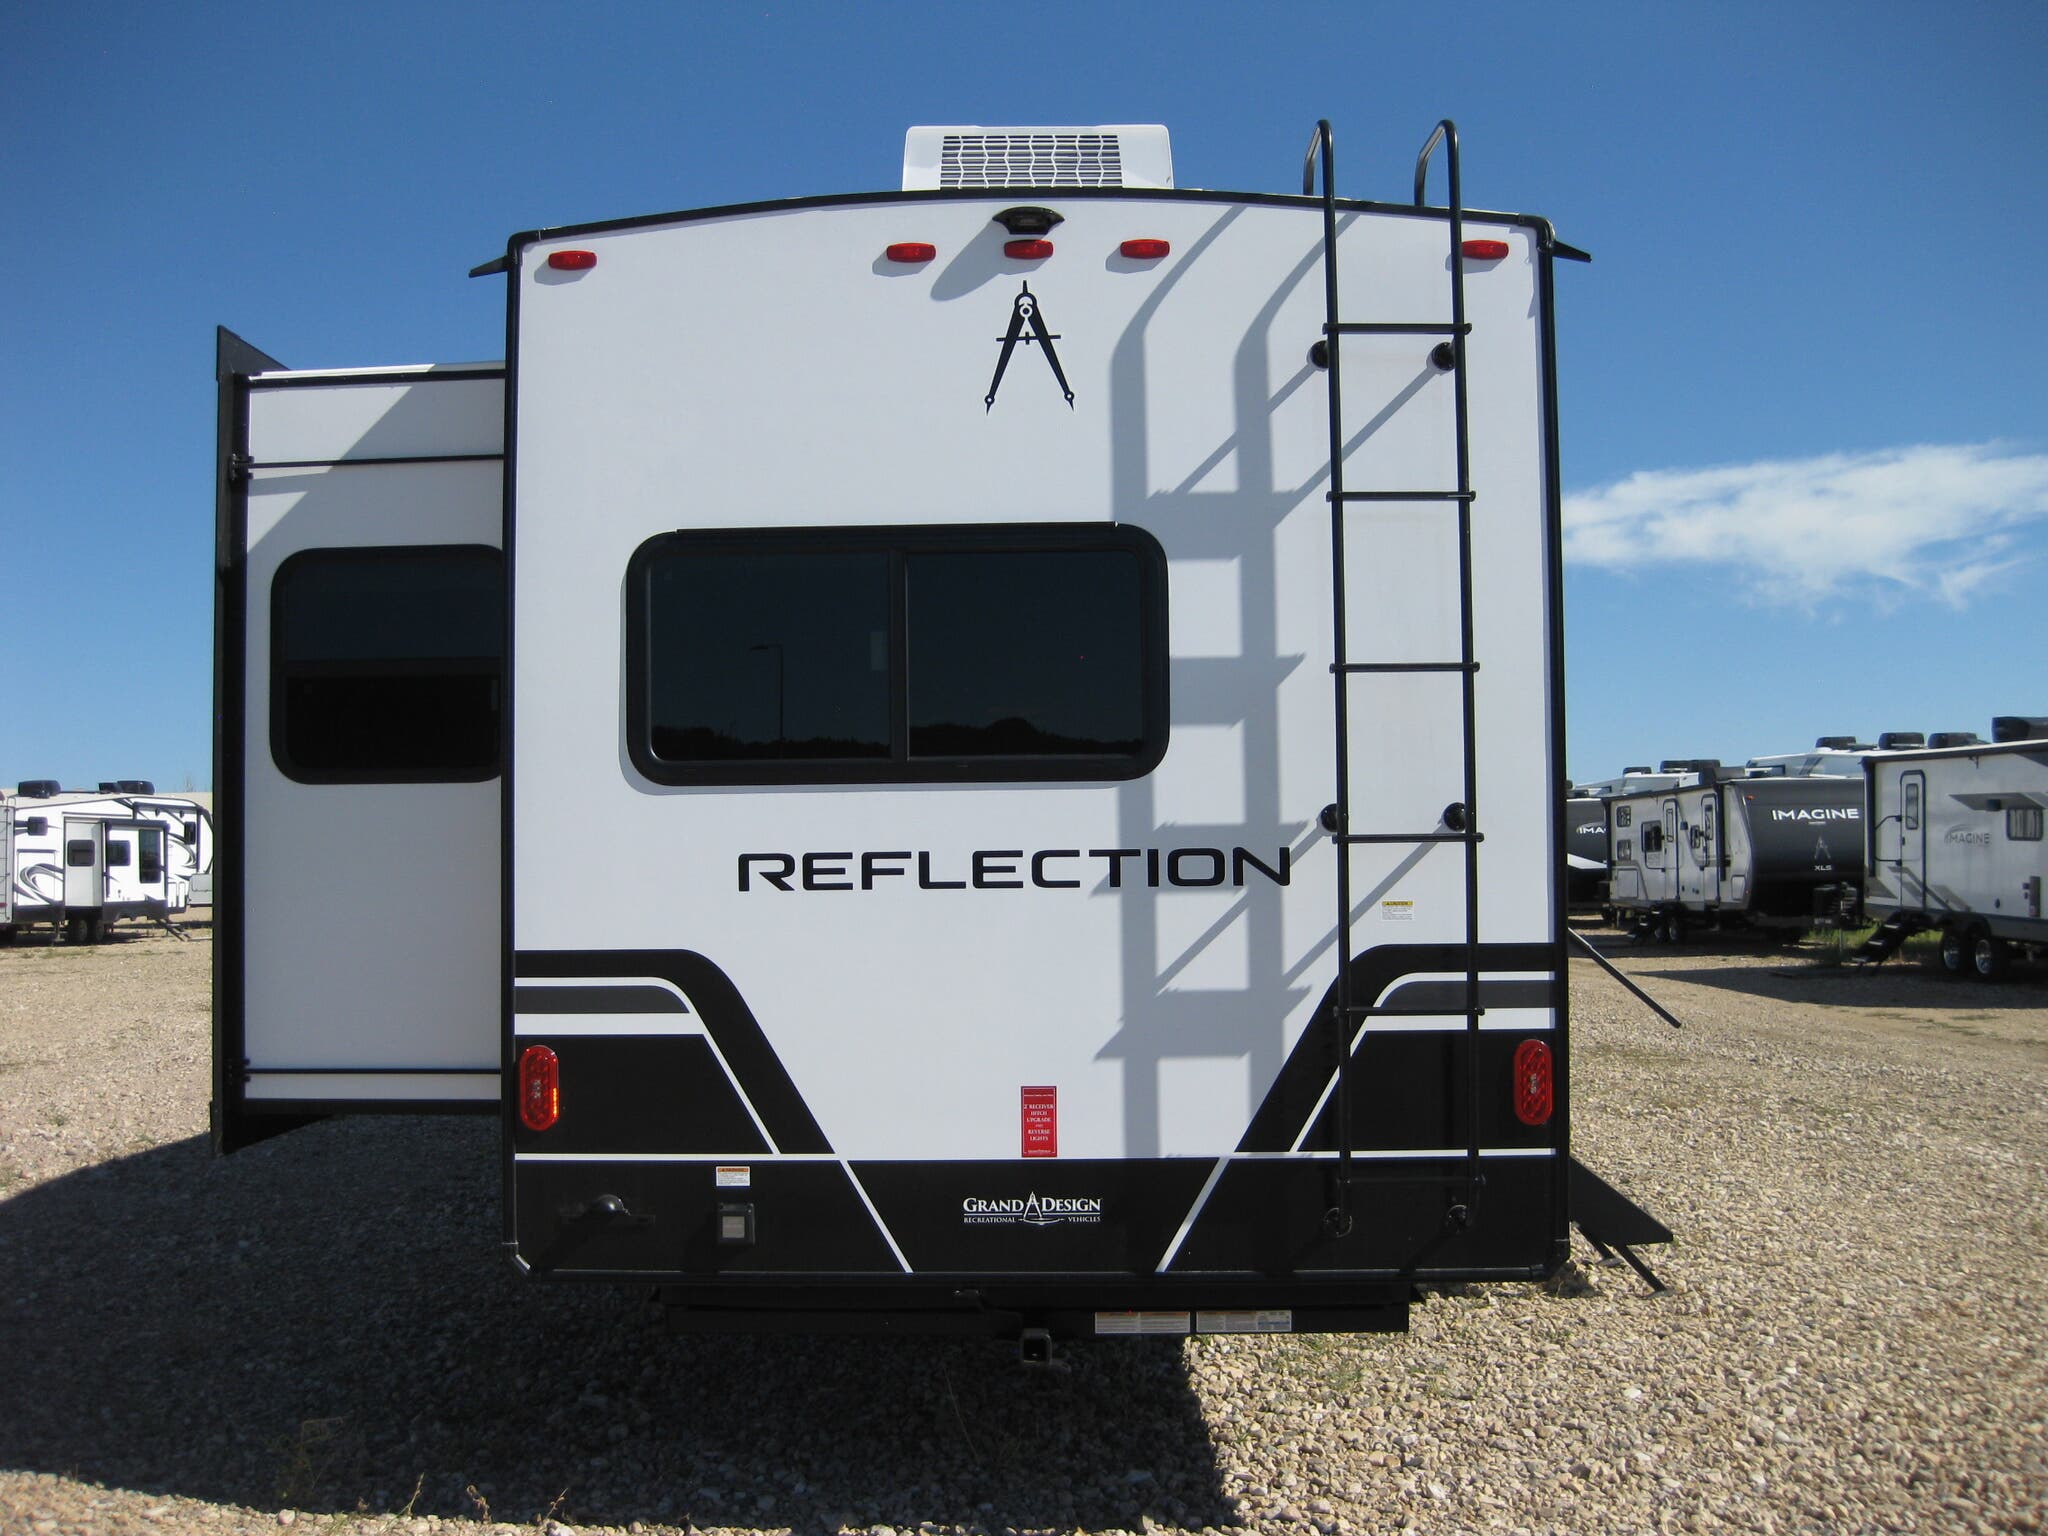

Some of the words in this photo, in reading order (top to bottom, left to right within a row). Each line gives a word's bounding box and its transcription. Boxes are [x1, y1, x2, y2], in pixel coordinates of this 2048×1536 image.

[1772, 808, 1859, 820] IMAGINE
[1579, 826, 1606, 834] IMA
[738, 846, 1291, 892] REFLECTION
[963, 1197, 1024, 1212] GRAND
[1041, 1197, 1102, 1212] DESIGN
